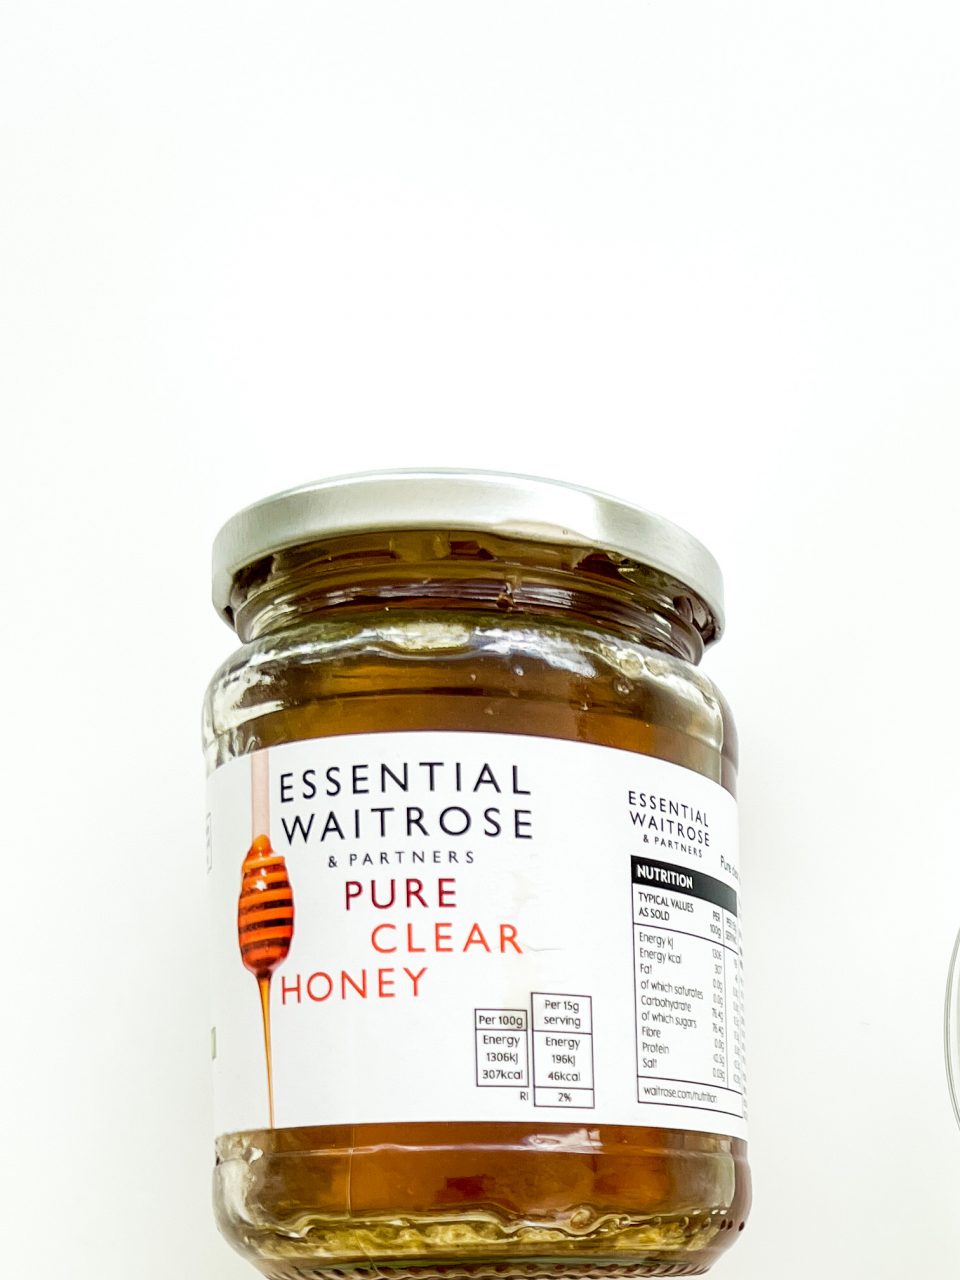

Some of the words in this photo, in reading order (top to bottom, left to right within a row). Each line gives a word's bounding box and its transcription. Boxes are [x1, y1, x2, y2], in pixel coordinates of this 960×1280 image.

[280, 762, 532, 803] ESSENTIAL
[628, 790, 709, 828] ESSENTIAL
[281, 806, 533, 845] WAITROSE
[629, 810, 710, 847] WAITROSE
[643, 834, 649, 843] &
[654, 836, 702, 858] PARTNERS
[328, 855, 338, 868] &
[350, 850, 474, 866] PARTNERS
[636, 864, 694, 889] NUTRITION
[345, 878, 457, 911] PURE
[638, 891, 670, 907] TYPICAL
[671, 898, 694, 913] VALUES
[639, 907, 649, 917] AS
[650, 908, 670, 921] SOLD
[371, 922, 523, 954] CLEAR
[639, 931, 666, 948] Energy
[639, 948, 666, 964] Energy
[668, 952, 682, 964] kcal
[640, 963, 652, 975] Fat
[282, 967, 428, 1005] HONEY
[641, 979, 650, 990] of
[651, 981, 673, 993] which
[674, 986, 704, 1000] saturates
[544, 999, 561, 1010] Per
[563, 1001, 580, 1014] 15g
[641, 995, 692, 1012] Carbohydrate
[479, 1015, 496, 1025] Per
[498, 1015, 523, 1029] 100g
[544, 1015, 581, 1029] serving
[641, 1010, 650, 1021] of
[652, 1011, 674, 1024] which
[675, 1016, 697, 1030] sugars
[642, 1026, 661, 1038] Fibre
[483, 1035, 520, 1048] Energy
[545, 1037, 581, 1050] Energy
[642, 1041, 670, 1054] Protein
[642, 1057, 658, 1069] Salt
[482, 1069, 523, 1080] 307kcal
[548, 1071, 581, 1082] 46kcal
[519, 1091, 529, 1101] RI
[558, 1092, 572, 1102] 2%
